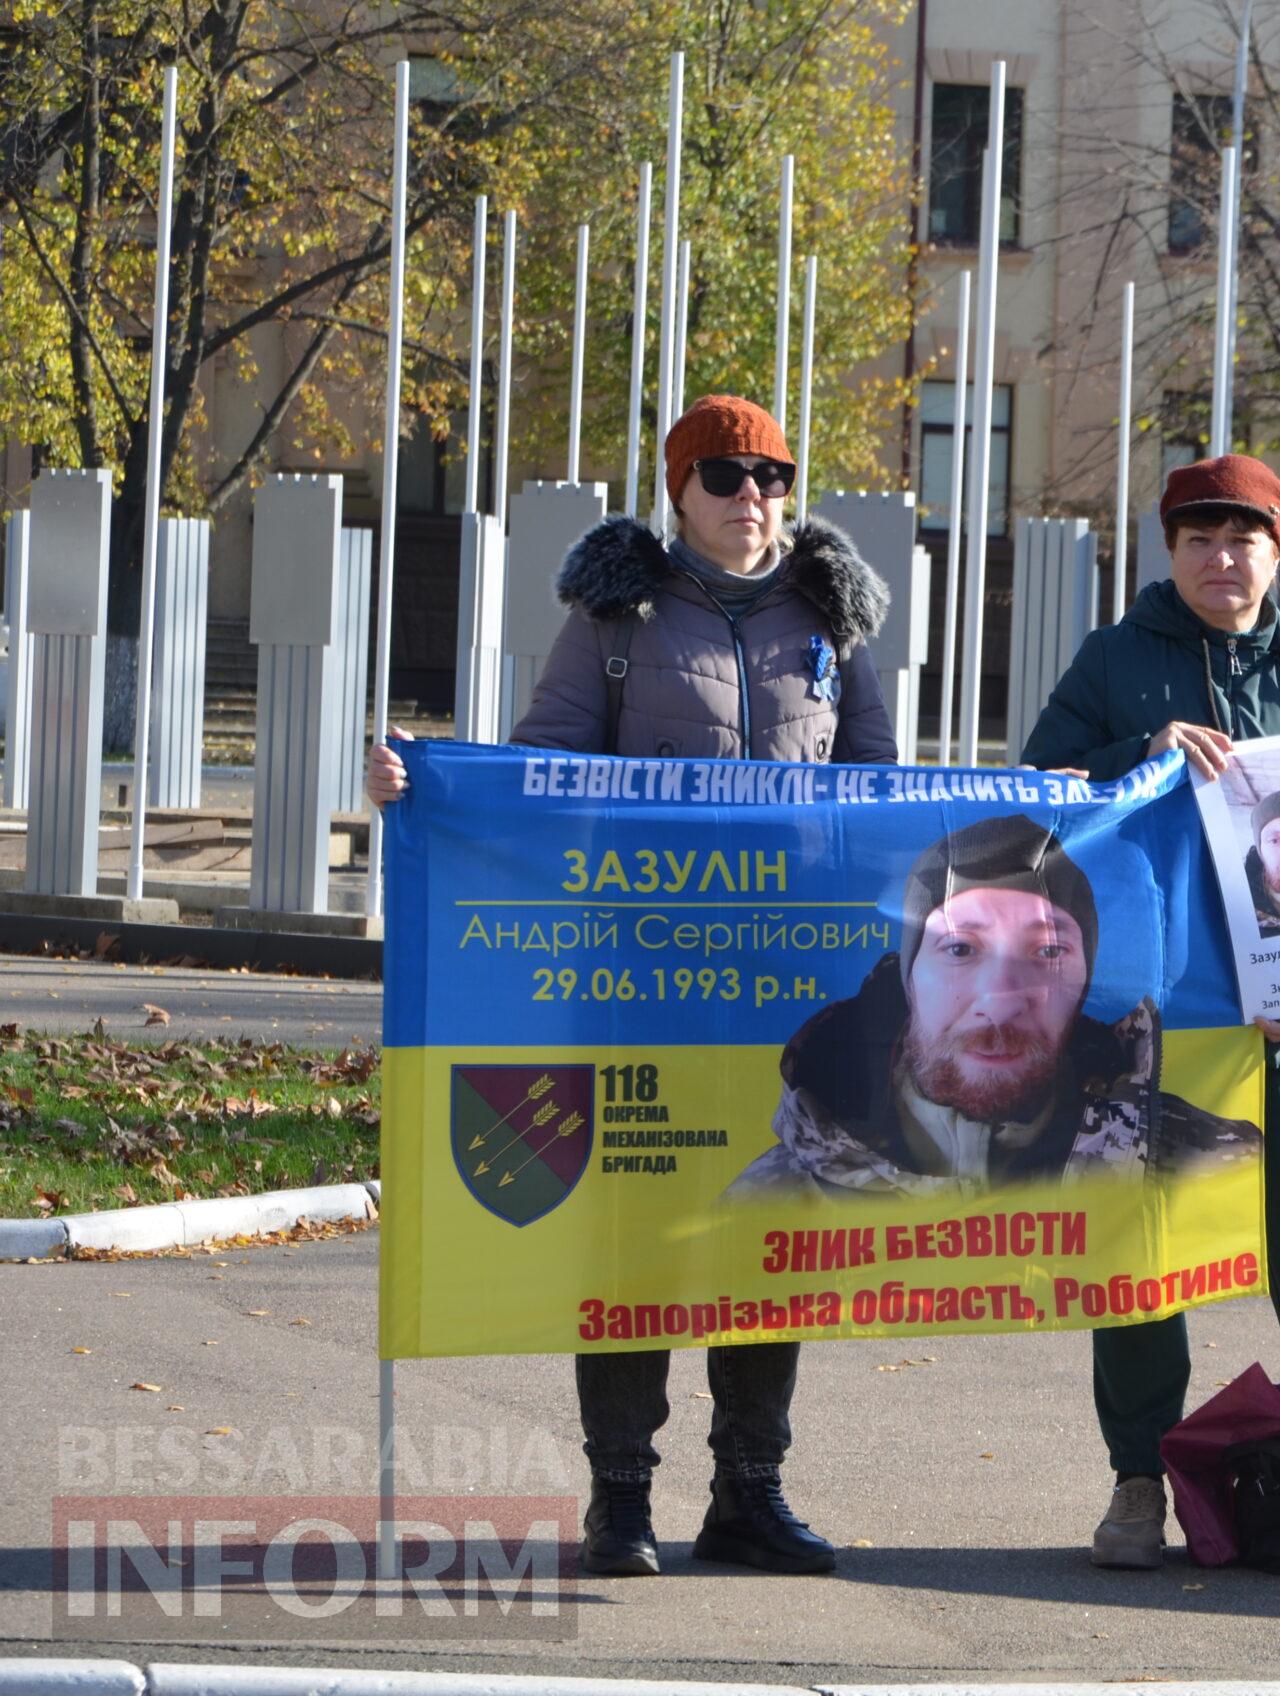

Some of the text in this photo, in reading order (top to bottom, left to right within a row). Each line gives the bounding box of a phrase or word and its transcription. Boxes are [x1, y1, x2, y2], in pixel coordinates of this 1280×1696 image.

[523, 757, 684, 798] БЕЗВІСТИ
[836, 770, 877, 804] НЕ
[887, 771, 1039, 804] ЗНАЧИТЬ
[561, 849, 787, 893] ЗАЗУЛІН
[459, 911, 889, 958] Андрій Сергійович
[532, 968, 827, 1008] 29.06.1993 р.н.
[600, 1064, 658, 1103] 118
[602, 1104, 669, 1123] ОКРЕМА
[602, 1130, 728, 1148] МЕХАНІЗОВАНА
[602, 1155, 677, 1175] БРИГАДА
[762, 1211, 1087, 1274] ЗНИК БЕЗВІСТИ
[578, 1252, 1259, 1341] Запорізька область, Роботине
